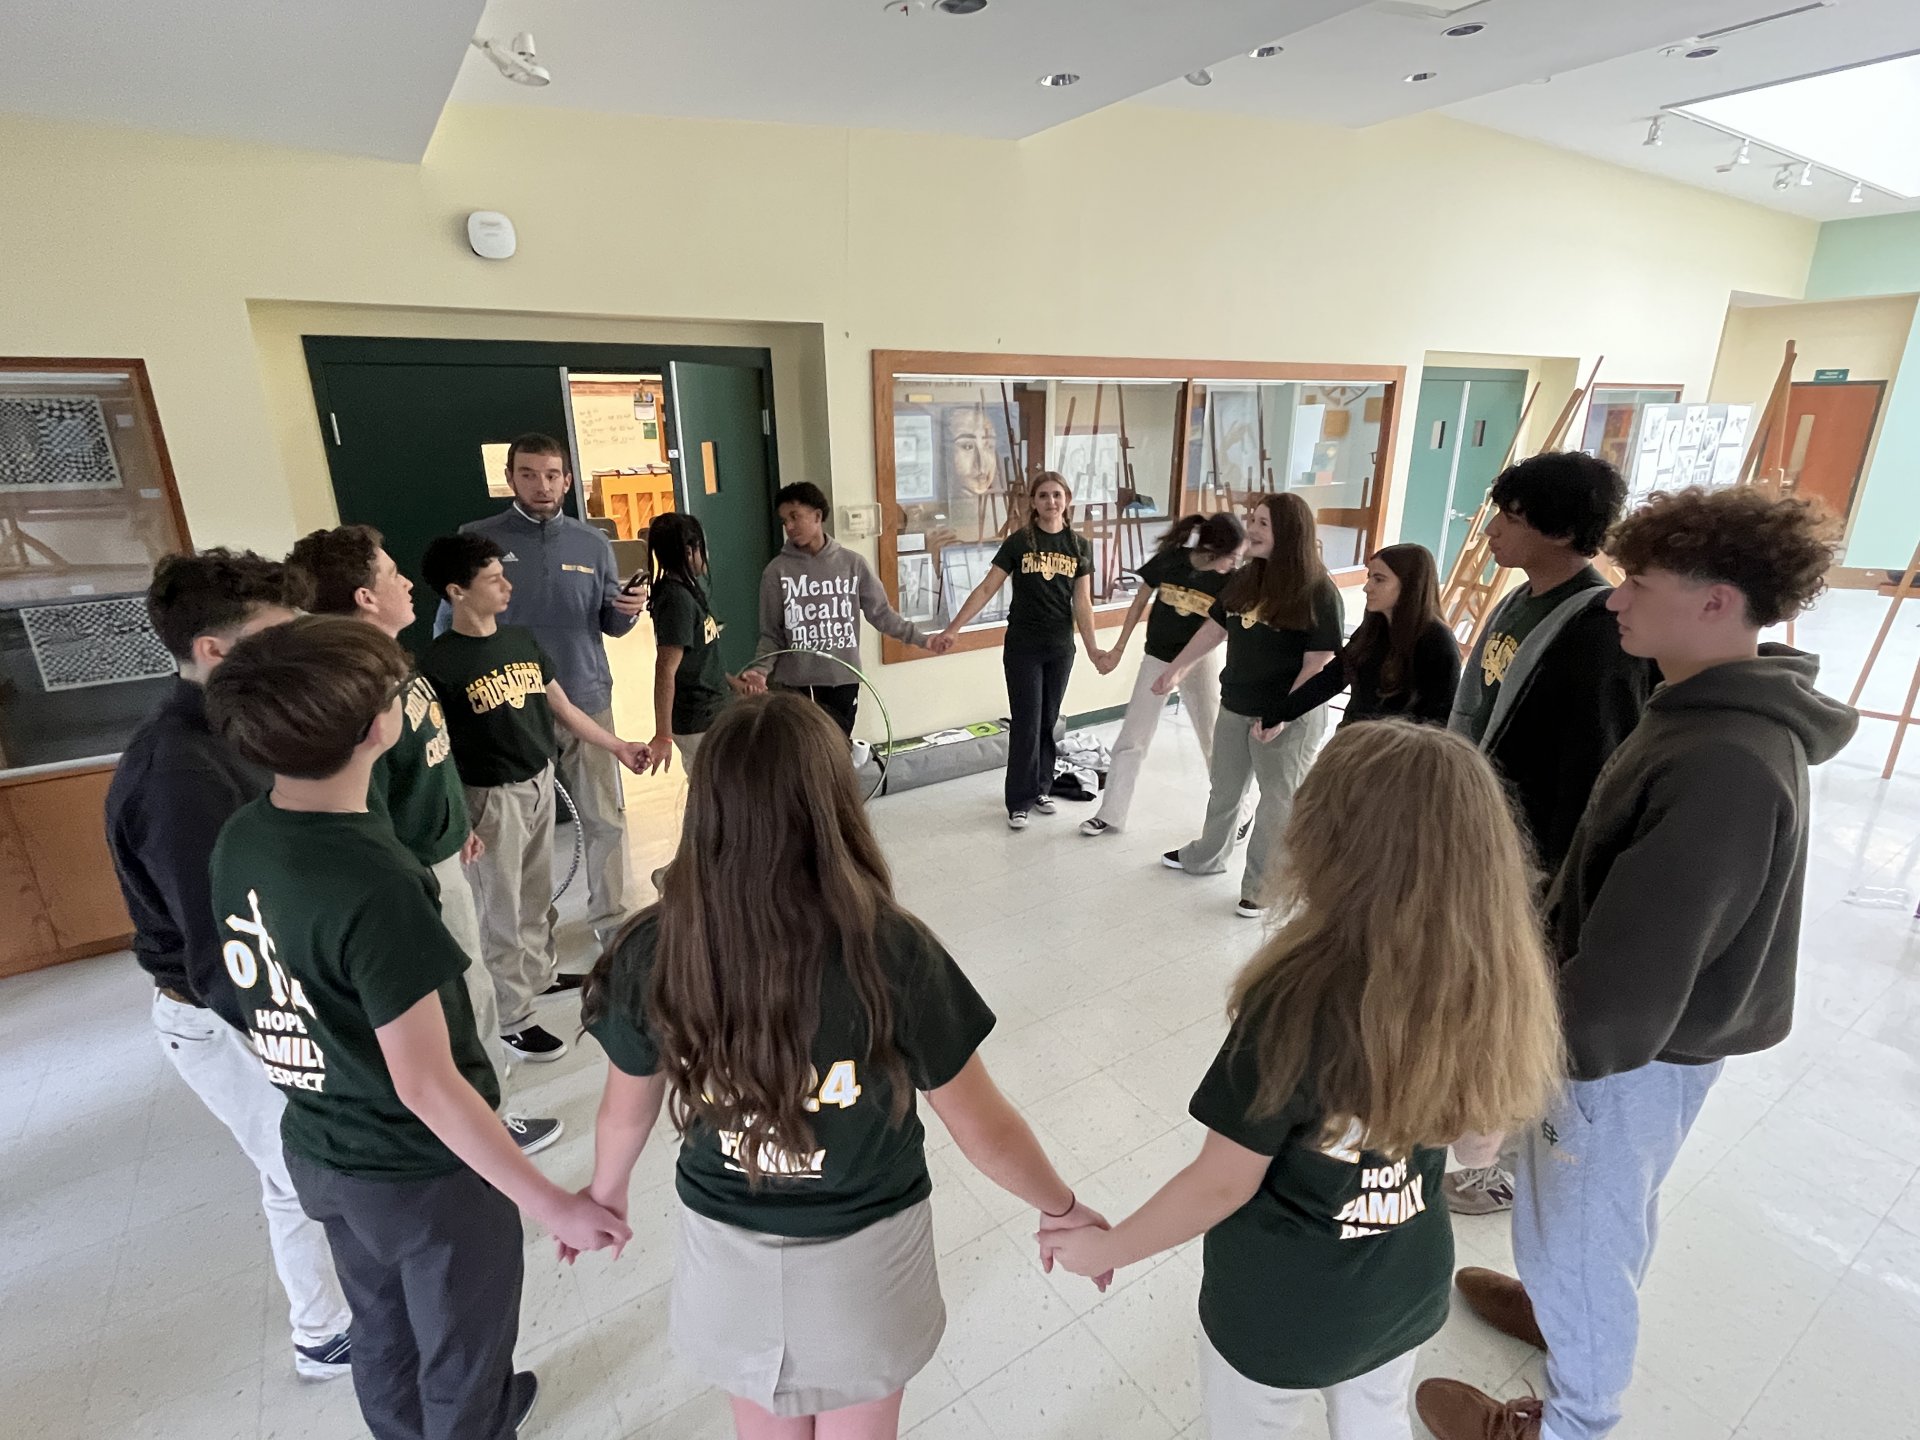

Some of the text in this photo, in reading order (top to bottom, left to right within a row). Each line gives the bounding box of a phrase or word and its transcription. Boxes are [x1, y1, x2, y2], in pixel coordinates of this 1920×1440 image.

[780, 574, 858, 605] Mental
[784, 596, 855, 630] health
[249, 1028, 326, 1070] AMILY
[261, 1058, 326, 1093] ESPECT
[1361, 1156, 1407, 1188] HOPE
[1332, 1173, 1426, 1224] FAMILY
